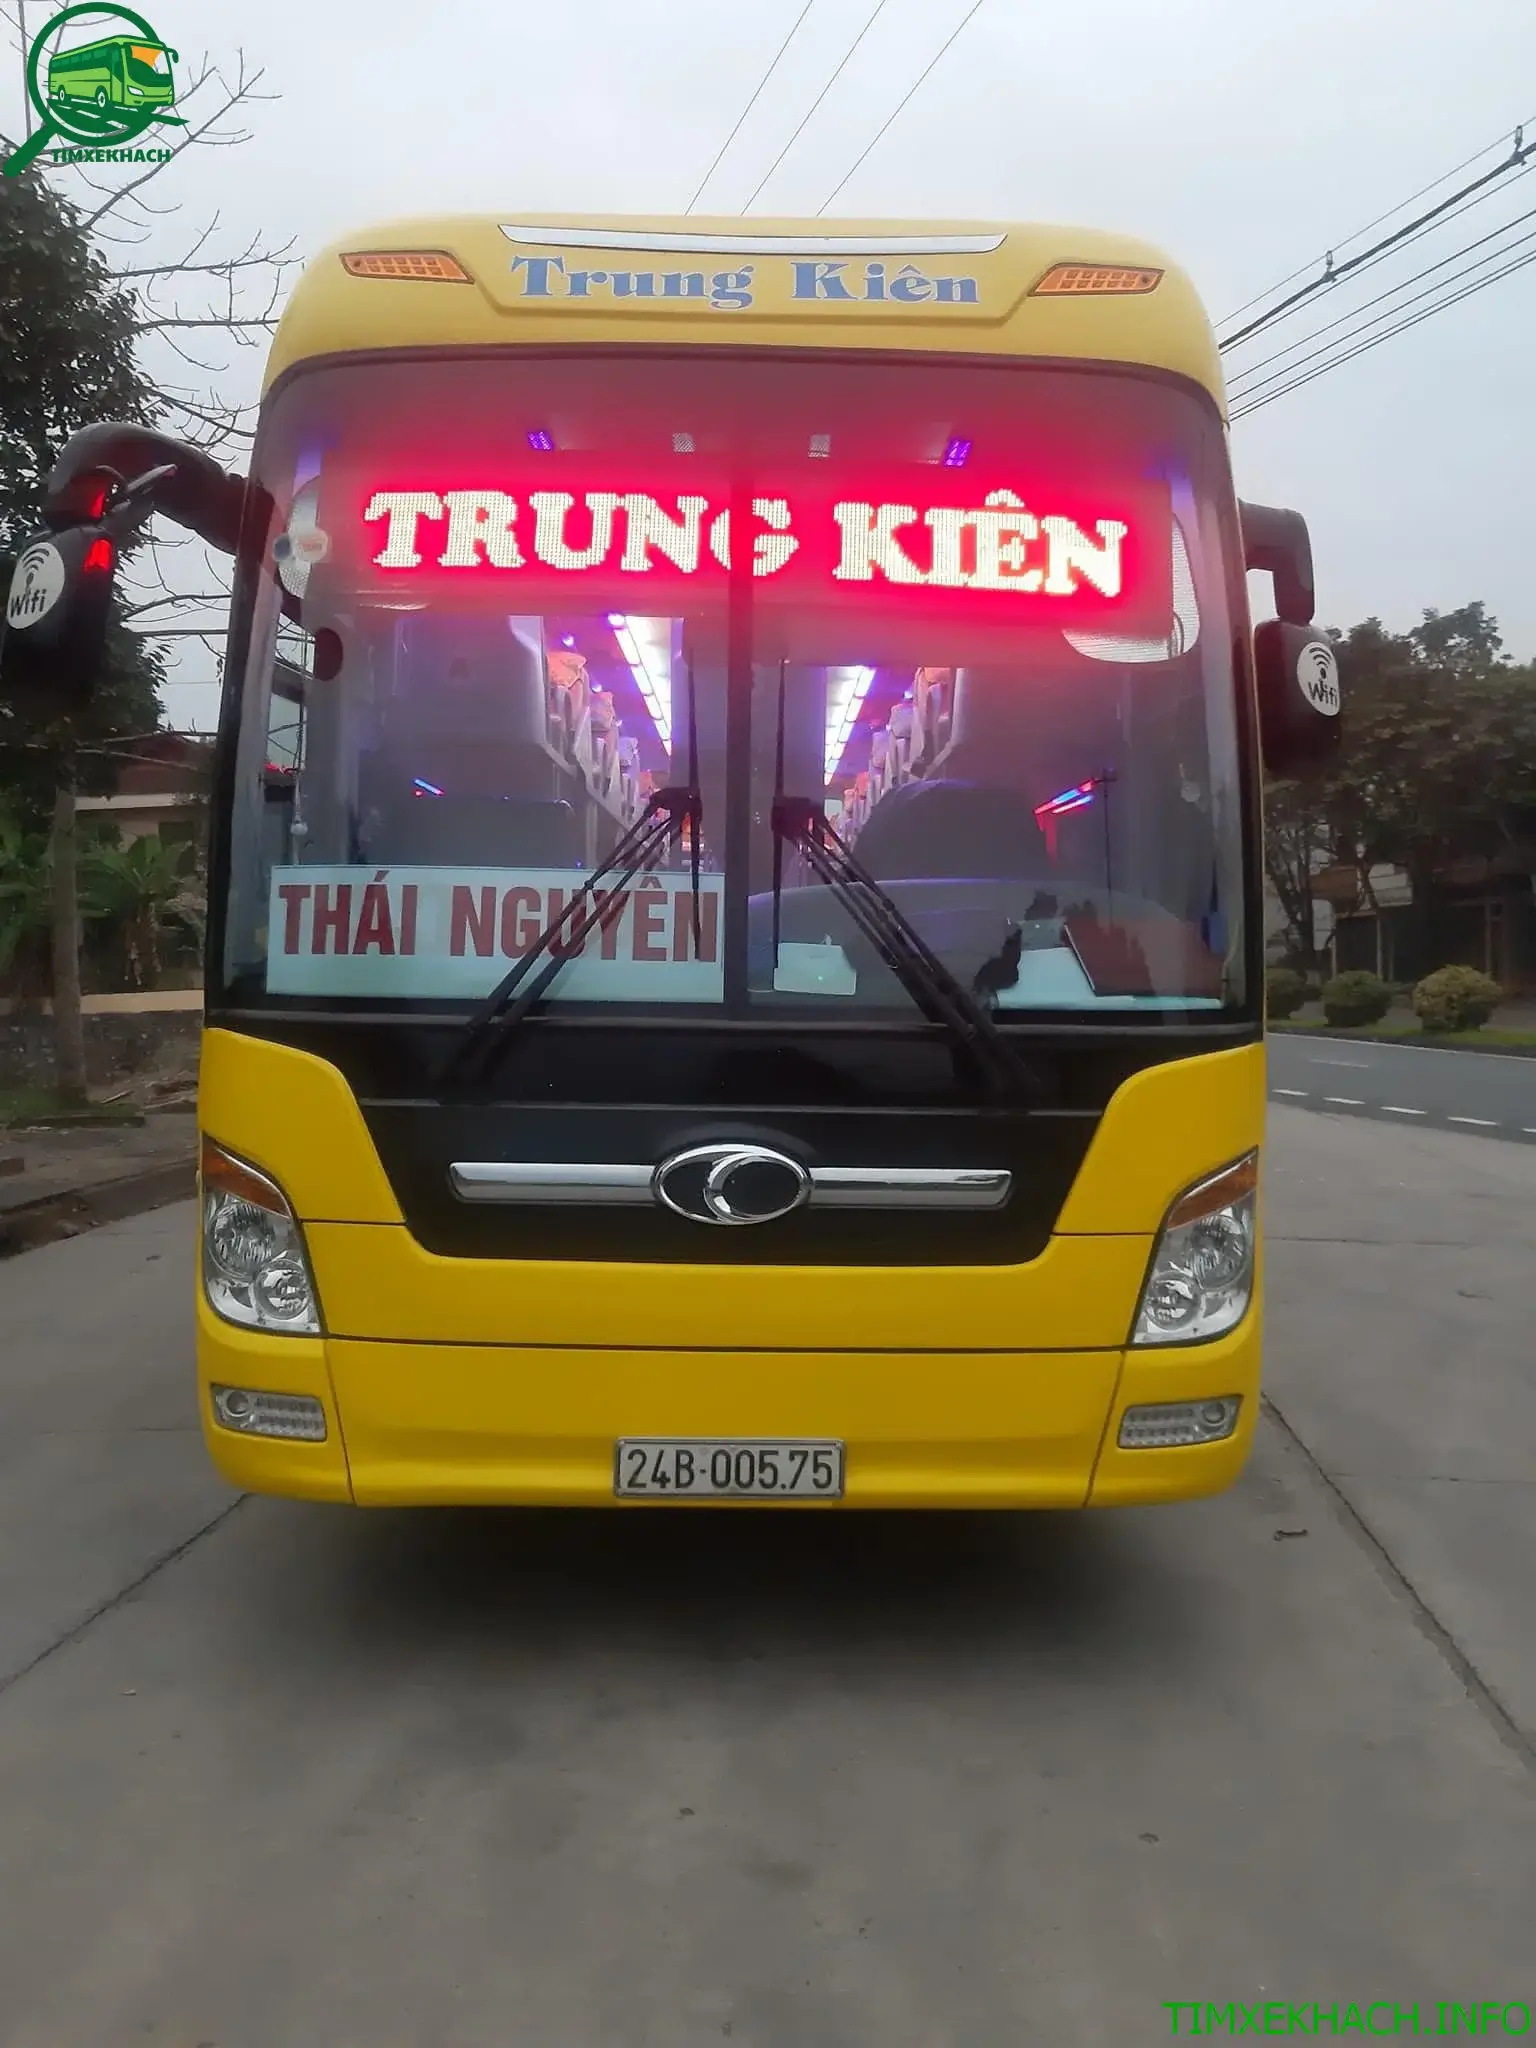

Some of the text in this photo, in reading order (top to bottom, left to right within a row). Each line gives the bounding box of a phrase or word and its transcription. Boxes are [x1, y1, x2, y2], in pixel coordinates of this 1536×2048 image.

[511, 256, 980, 310] Trung Kiên
[364, 489, 1128, 598] TRUNG KIÊN
[278, 870, 718, 963] THÁI NGUYÊN
